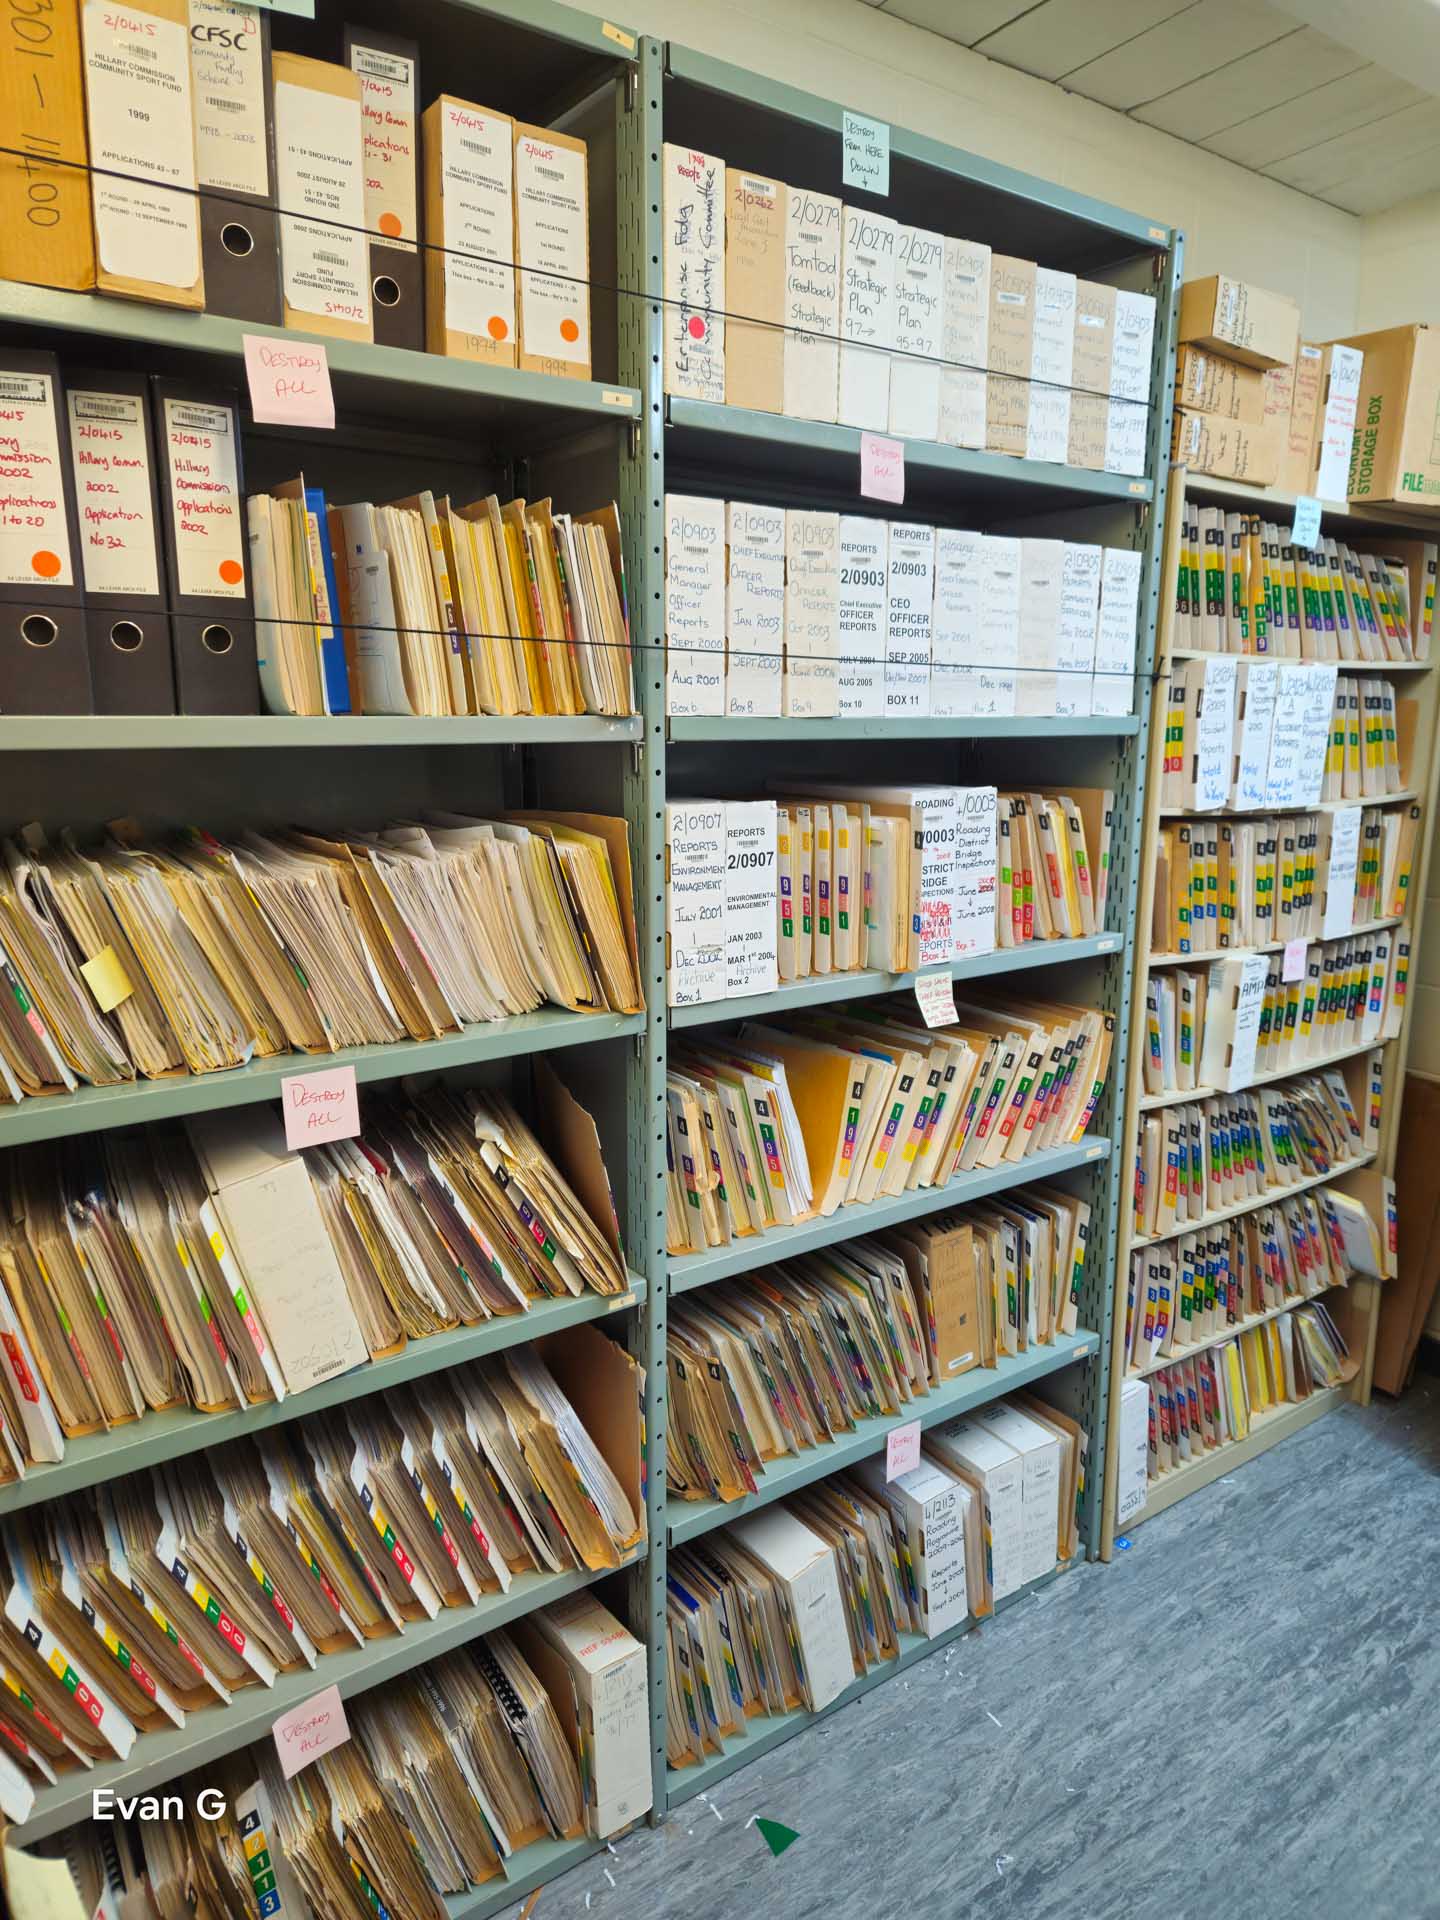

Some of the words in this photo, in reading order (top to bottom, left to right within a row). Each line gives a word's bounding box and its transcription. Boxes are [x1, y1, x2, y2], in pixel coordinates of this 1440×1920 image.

[104, 14, 158, 37] 2/0415
[242, 16, 257, 35] D
[190, 24, 249, 51] CFSC
[94, 52, 128, 68] HILLARY
[128, 62, 176, 83] COMMISSION
[88, 60, 135, 79] COMMUNITY
[135, 72, 161, 89] SPORT
[162, 82, 183, 93] FUND
[127, 108, 151, 122] 1999
[449, 110, 485, 132] 2/0415
[101, 150, 156, 171] APPLICATIONS
[308, 149, 353, 166] APPLICATIONS
[850, 157, 880, 175] DOWN
[445, 171, 476, 187] COMMUNITY
[449, 165, 472, 179] HILLARY
[472, 172, 504, 188] COMMISSION
[304, 195, 327, 206] ROUND
[522, 192, 550, 205] COMMUNITY
[525, 186, 546, 198] HILLARY
[735, 188, 775, 210] 2/0262
[696, 166, 717, 250] Committee
[792, 195, 841, 232] 2/0279
[308, 226, 353, 242] APPLICATIONS
[847, 217, 895, 255] 2/0279
[787, 245, 838, 275] Tomtod
[898, 234, 943, 273] 2/0279
[296, 270, 318, 282] SPORT
[318, 275, 355, 289] COMMUNITY
[292, 277, 333, 293] COMMISSION
[787, 276, 837, 301] (Feedback)
[846, 267, 888, 305] Strategic
[848, 293, 874, 318] Plan
[894, 283, 938, 318] Strategic
[324, 302, 364, 319] 2/0415
[791, 303, 833, 333] Strategic
[897, 306, 923, 330] Plan
[793, 327, 817, 345] Plan
[845, 319, 863, 337] 97
[895, 335, 934, 352] 95-97
[259, 347, 322, 373] DESTROY
[275, 378, 319, 395] ALL
[1367, 394, 1383, 425] BOX
[78, 426, 123, 441] 2/0415
[79, 451, 110, 471] Hillary
[174, 459, 210, 477] Hillary
[1357, 428, 1378, 495] STORAGE
[86, 481, 120, 494] 2002
[1402, 472, 1424, 492] FILE
[9, 515, 23, 526] to
[26, 516, 45, 528] 20
[85, 506, 144, 526] Application
[181, 520, 209, 536] 2002
[671, 516, 718, 544] 2/0903
[733, 511, 785, 544] 2/0903
[791, 520, 836, 550] 2/0903
[892, 528, 931, 541] REPORTS
[90, 531, 105, 547] No
[107, 535, 127, 549] 32
[840, 542, 878, 555] REPORTS
[668, 555, 710, 575] General
[891, 560, 928, 578] 2/0903
[669, 574, 713, 596] Manager
[840, 568, 886, 587] 2/0903
[669, 594, 702, 611] Officer
[839, 599, 859, 609] Chief
[859, 600, 883, 609] Executive
[890, 597, 911, 609] CEO
[668, 613, 710, 629] Reports
[839, 609, 874, 620] OFFICER
[889, 611, 930, 626] OFFICER
[756, 615, 781, 635] 2003
[839, 621, 877, 632] REPORTS
[888, 626, 931, 639] REPORTS
[698, 639, 724, 650] 2000
[757, 656, 782, 675] 2003
[887, 651, 907, 663] SEP
[908, 652, 930, 664] 2005
[696, 675, 720, 686] 2001
[838, 677, 856, 687] AUG
[856, 677, 873, 687] 2005
[671, 701, 690, 713] Box
[730, 699, 746, 713] Box
[838, 700, 853, 709] Box
[854, 700, 863, 709] 10
[887, 695, 908, 705] BOX
[909, 695, 920, 705] 11
[673, 812, 722, 837] 2/0907
[727, 827, 767, 838] REPORTS
[955, 822, 992, 836] Roading
[672, 838, 719, 852] REPORTS
[958, 837, 990, 849] District
[727, 851, 775, 870] 2/0907
[955, 850, 983, 862] Bridge
[955, 858, 996, 872] Inspections
[672, 879, 723, 893] MANAGEMENT
[957, 885, 977, 896] June
[727, 891, 777, 904] ENVIRONMENTAL
[727, 900, 770, 911] MANAGEMENT
[699, 905, 724, 921] 2001
[956, 909, 976, 920] June
[727, 933, 745, 944] JAN
[745, 931, 763, 942] 2003
[675, 950, 696, 970] DEC
[727, 955, 746, 965] MAR
[727, 977, 744, 987] Box
[744, 976, 750, 985] 2
[676, 991, 694, 1004] Box
[694, 989, 703, 1001] 1
[290, 1083, 347, 1108] DESTROY
[306, 1112, 346, 1129] ALL
[926, 1515, 957, 1537] Roading
[930, 1559, 959, 1580] Reports
[930, 1579, 948, 1594] June
[282, 1711, 331, 1744] DESTROY
[300, 1734, 329, 1754] ALL
